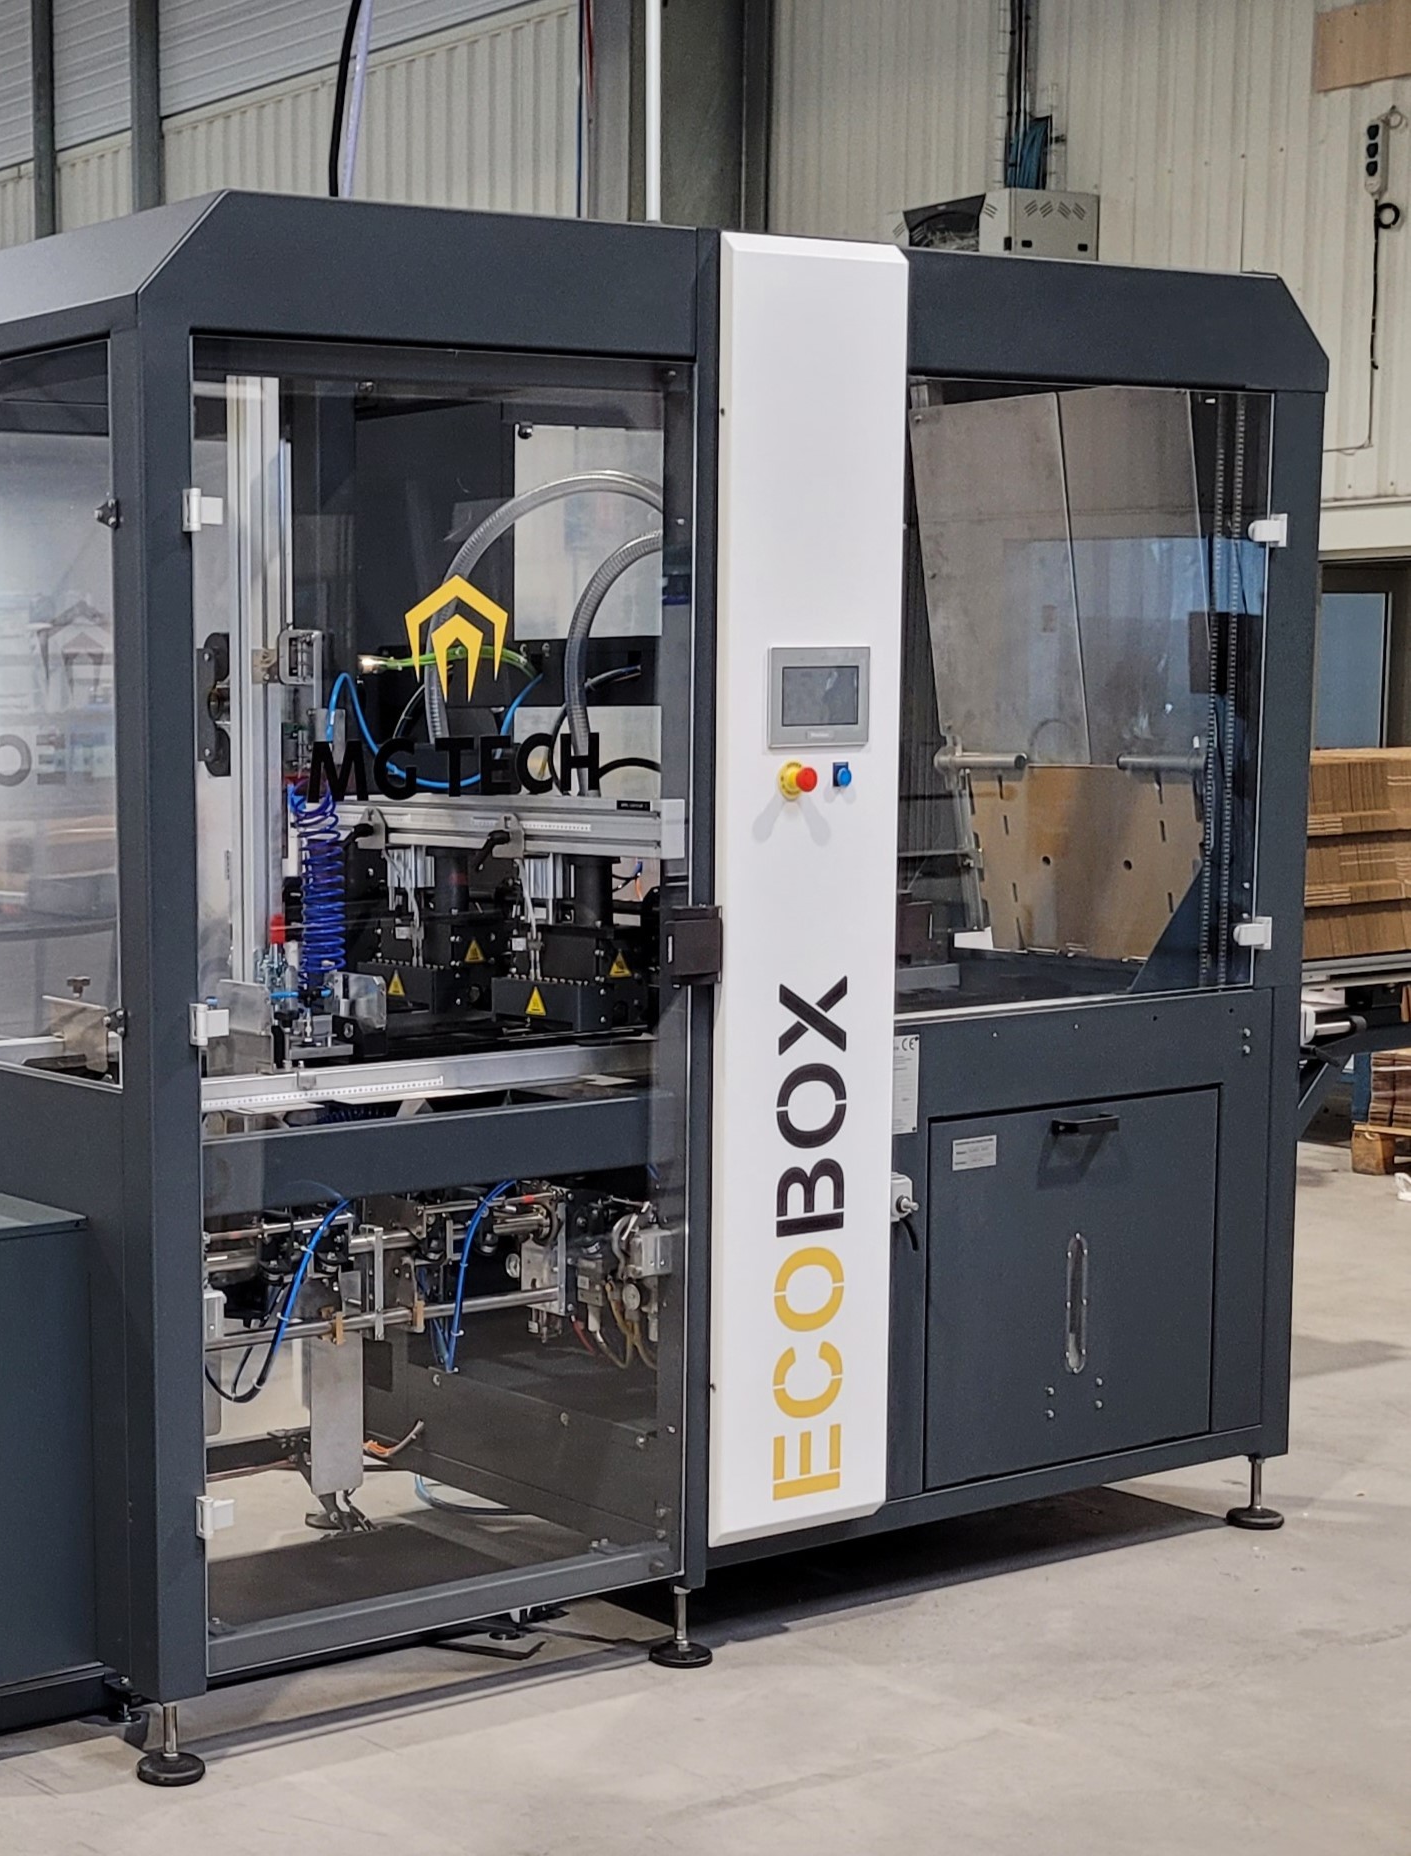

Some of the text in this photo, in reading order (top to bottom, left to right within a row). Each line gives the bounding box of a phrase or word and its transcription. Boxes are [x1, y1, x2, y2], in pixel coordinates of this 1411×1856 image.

[307, 732, 601, 802] MG TECH
[773, 975, 849, 1500] ECOBOX
